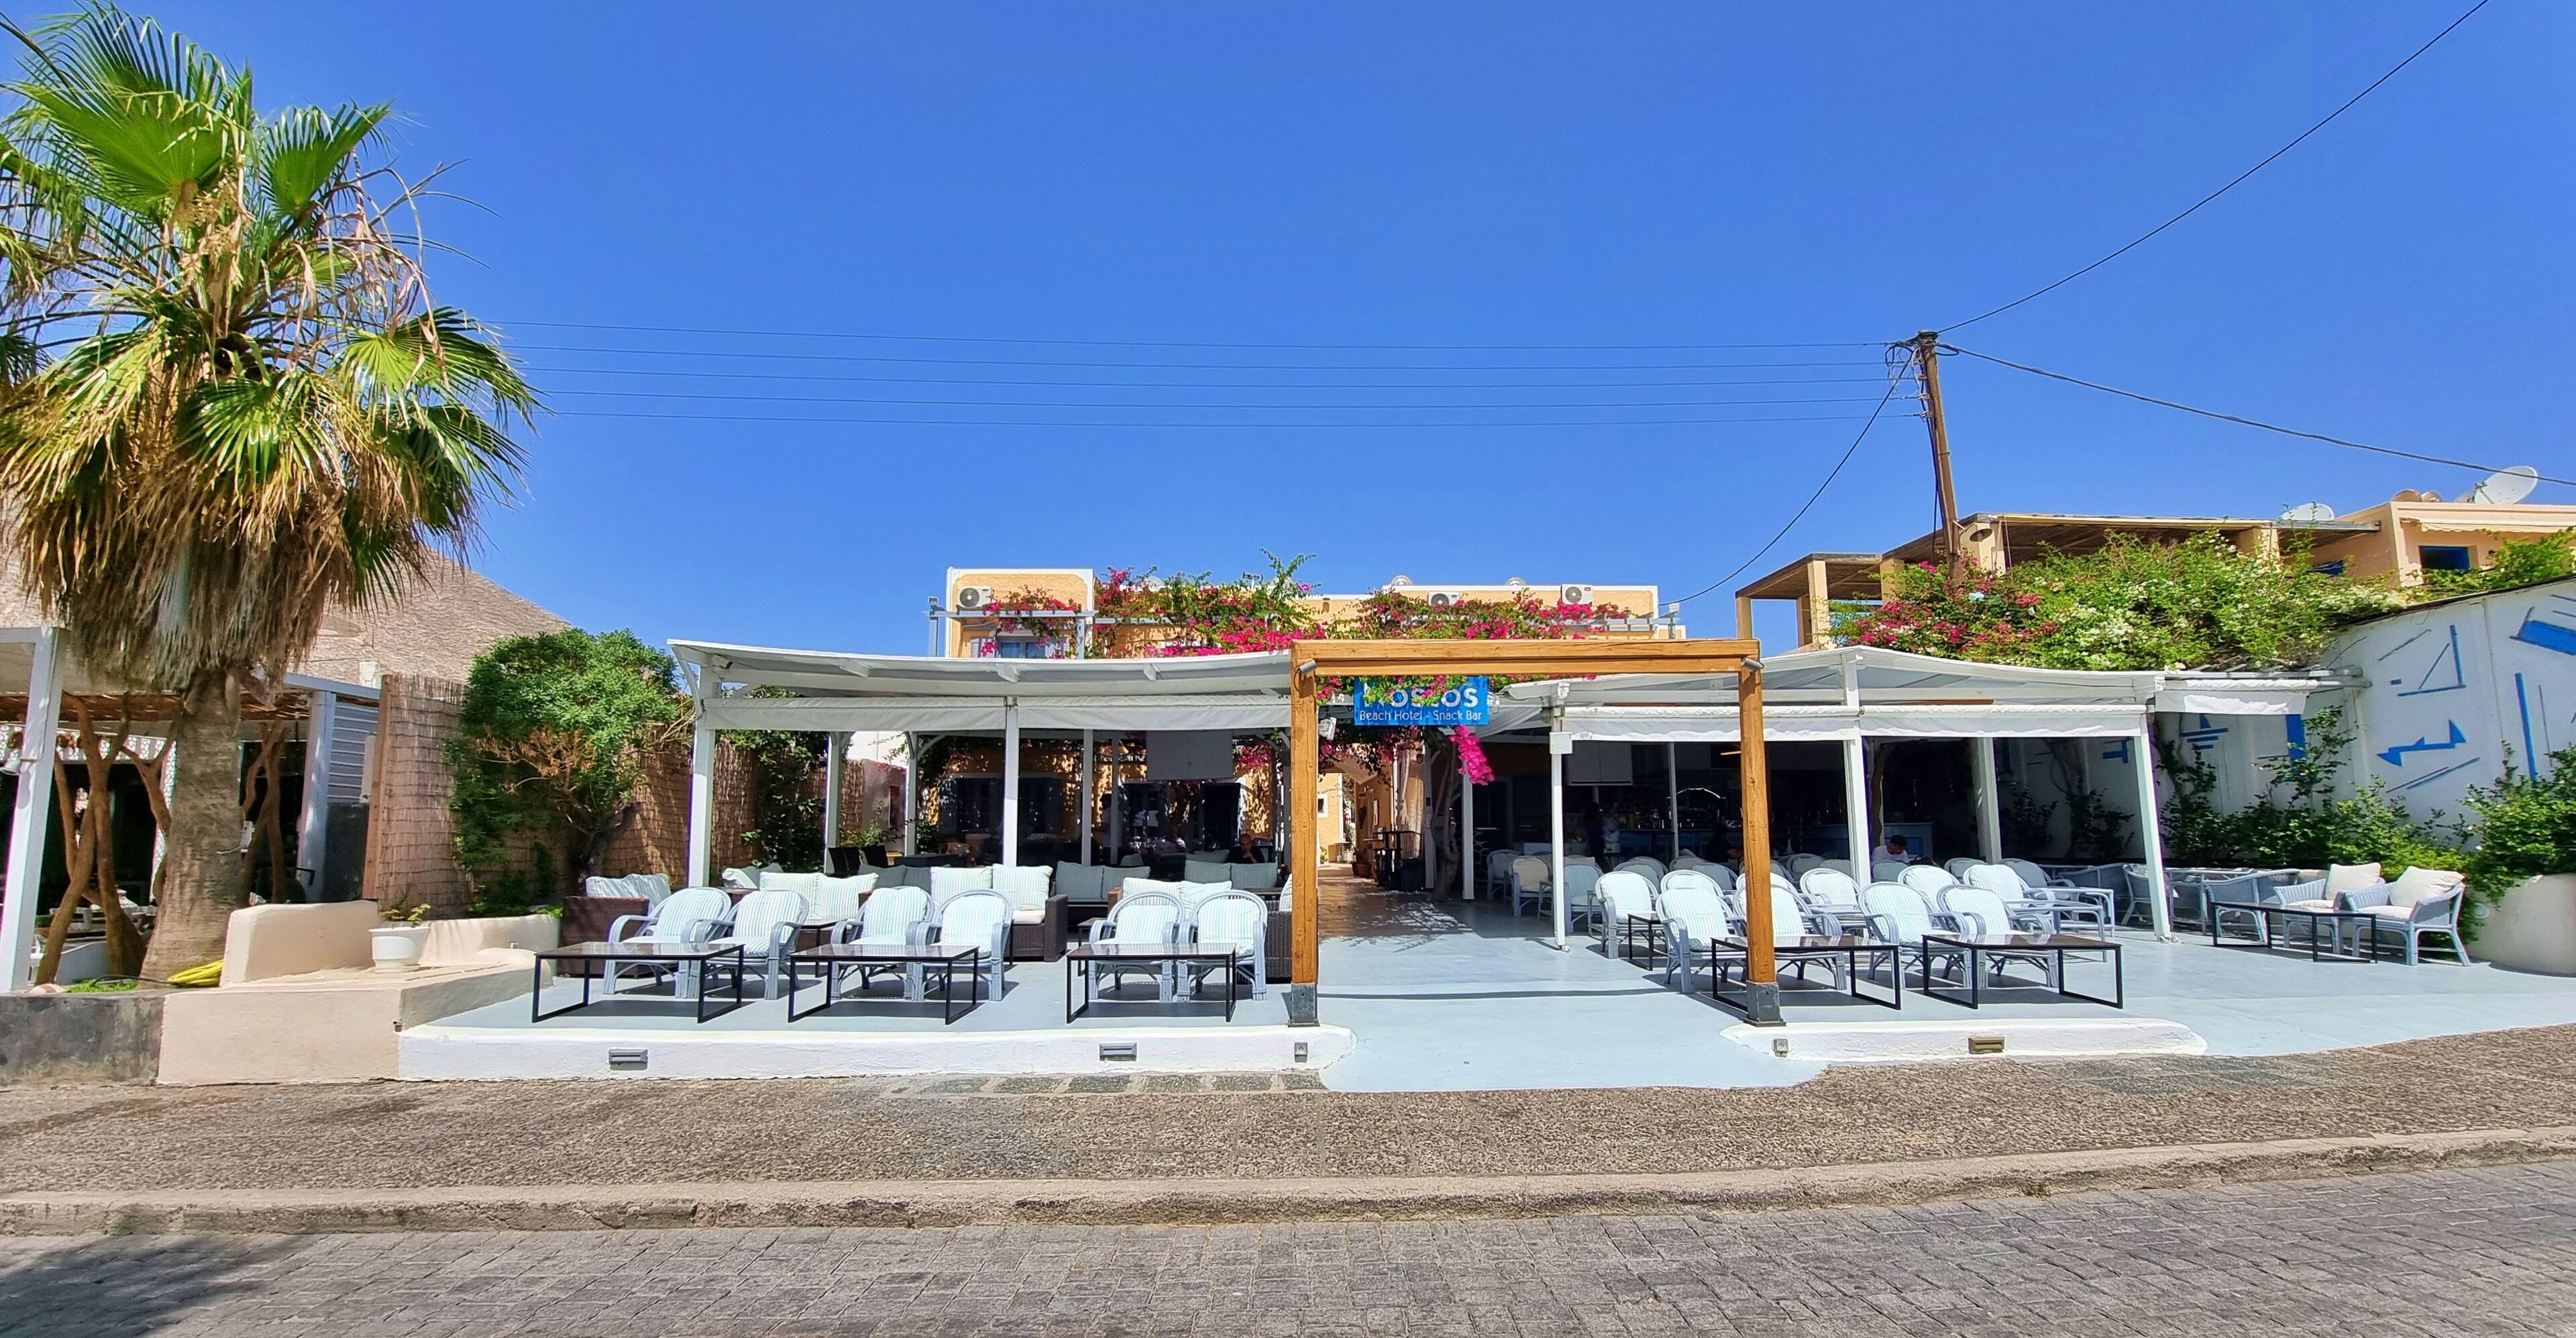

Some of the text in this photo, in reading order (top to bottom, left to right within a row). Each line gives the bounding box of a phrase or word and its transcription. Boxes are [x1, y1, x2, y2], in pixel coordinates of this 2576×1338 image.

[1360, 710, 1391, 721] Beach
[1394, 710, 1422, 721] Hotel
[1433, 710, 1463, 721] Snack
[1466, 710, 1482, 721] Bar
